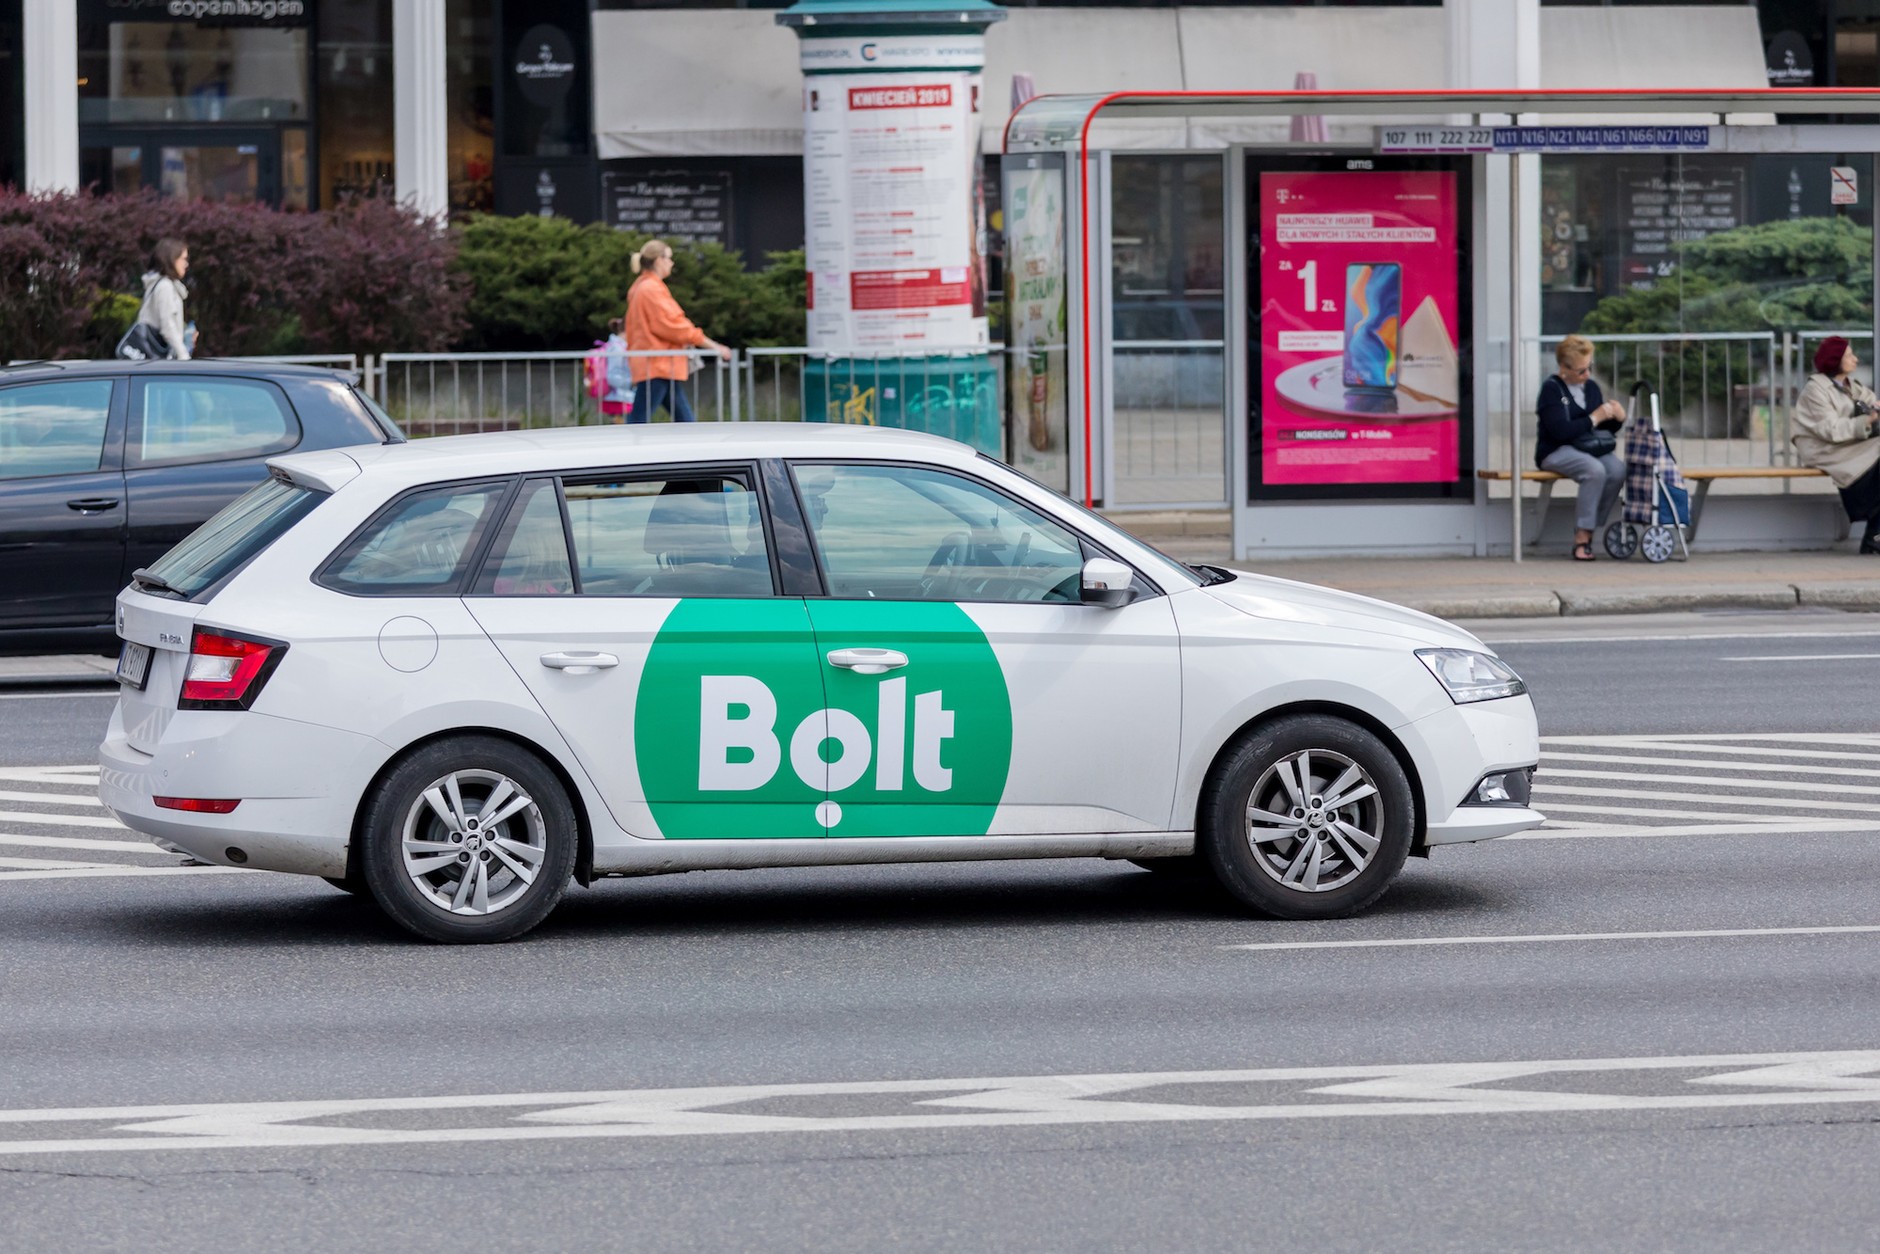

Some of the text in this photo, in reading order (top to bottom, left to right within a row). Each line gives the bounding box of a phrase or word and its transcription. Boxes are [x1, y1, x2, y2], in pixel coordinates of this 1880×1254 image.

[168, 0, 304, 20] copenhagen
[918, 89, 949, 105] 2019
[1385, 129, 1708, 144] 107 111 222 227 N11 N16 N21 N41 N61 N66 N71 N91
[1346, 159, 1374, 170] ams
[1278, 216, 1370, 226] NAJNOWSZY HUAWEI
[1278, 231, 1297, 239] DLA
[1299, 231, 1339, 239] NOWYCH
[1347, 230, 1384, 239] STAŁYCH
[1387, 229, 1432, 239] KLIENTÓW
[1278, 260, 1293, 270] ZA
[1297, 260, 1317, 312] 1
[1321, 300, 1338, 312] ZŁ
[1295, 428, 1346, 440] NONSENSÓW
[698, 675, 955, 793] Bolt
